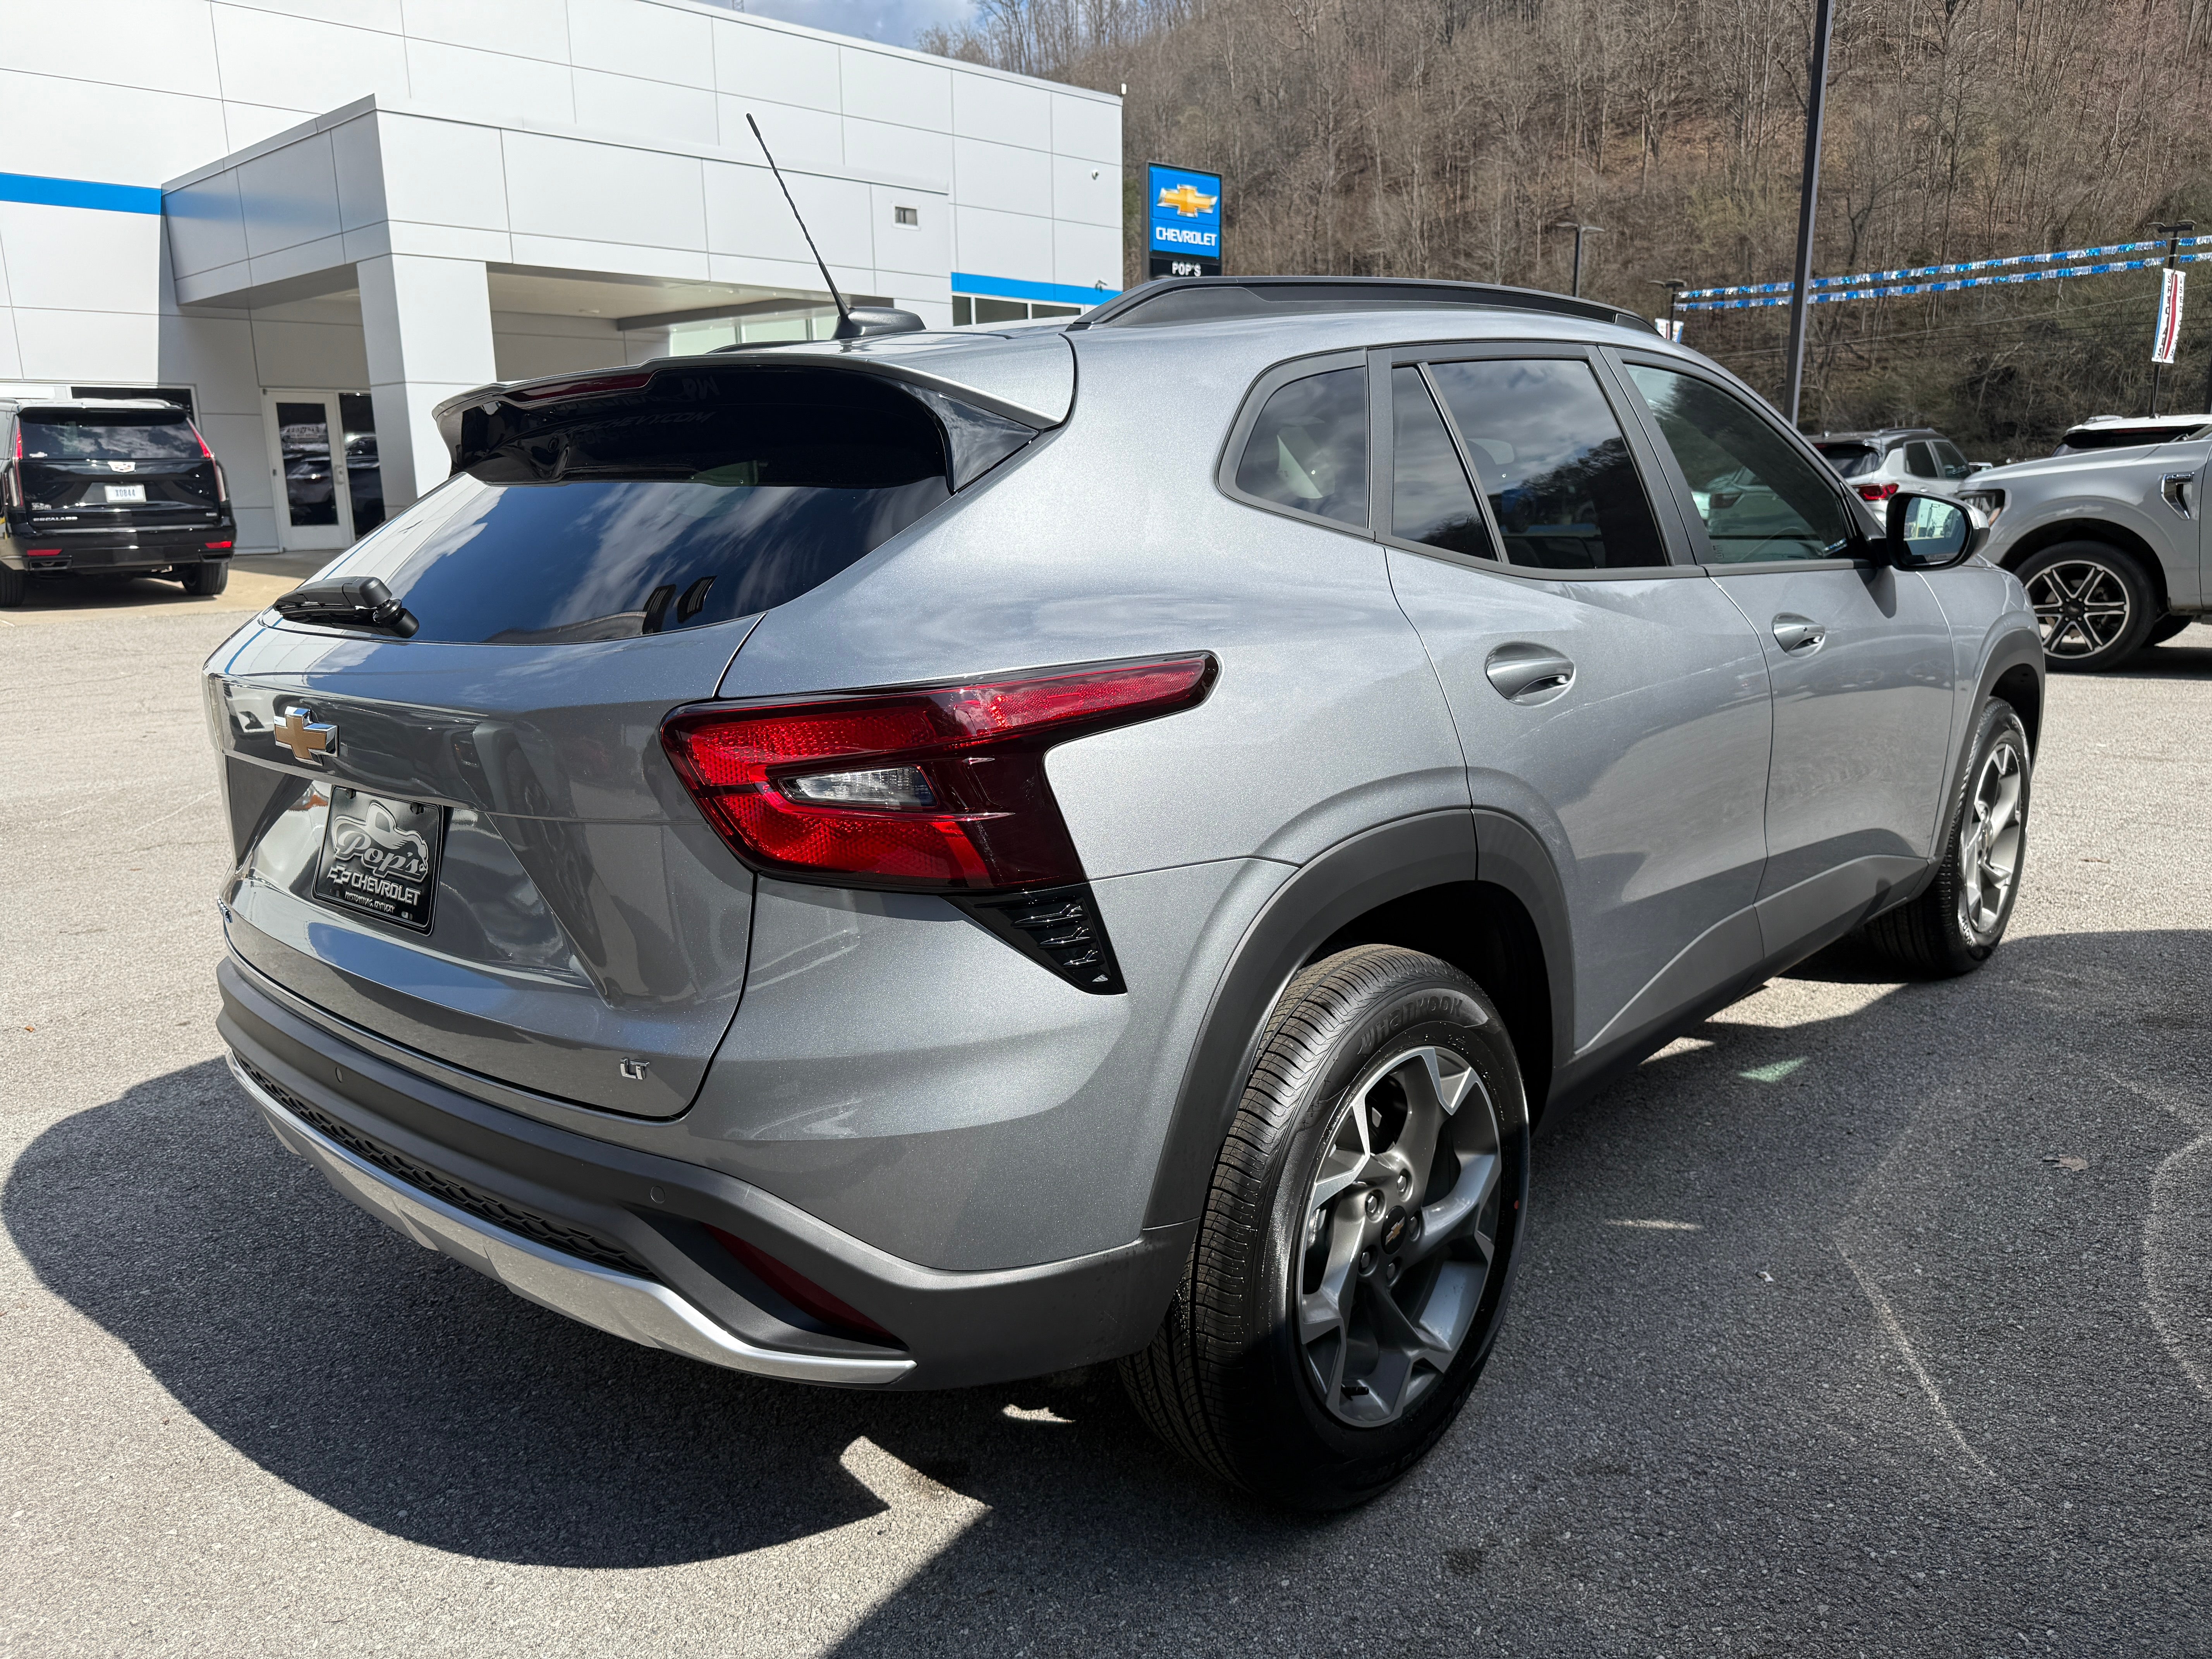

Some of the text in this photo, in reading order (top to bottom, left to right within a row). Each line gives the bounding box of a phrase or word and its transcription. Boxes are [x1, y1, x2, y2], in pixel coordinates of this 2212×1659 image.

[1156, 227, 1217, 246] CHEVROLET
[1172, 261, 1201, 277] POP'S
[338, 830, 426, 876] Pop's
[351, 872, 421, 906] CHEVROLET
[620, 1057, 650, 1080] LT
